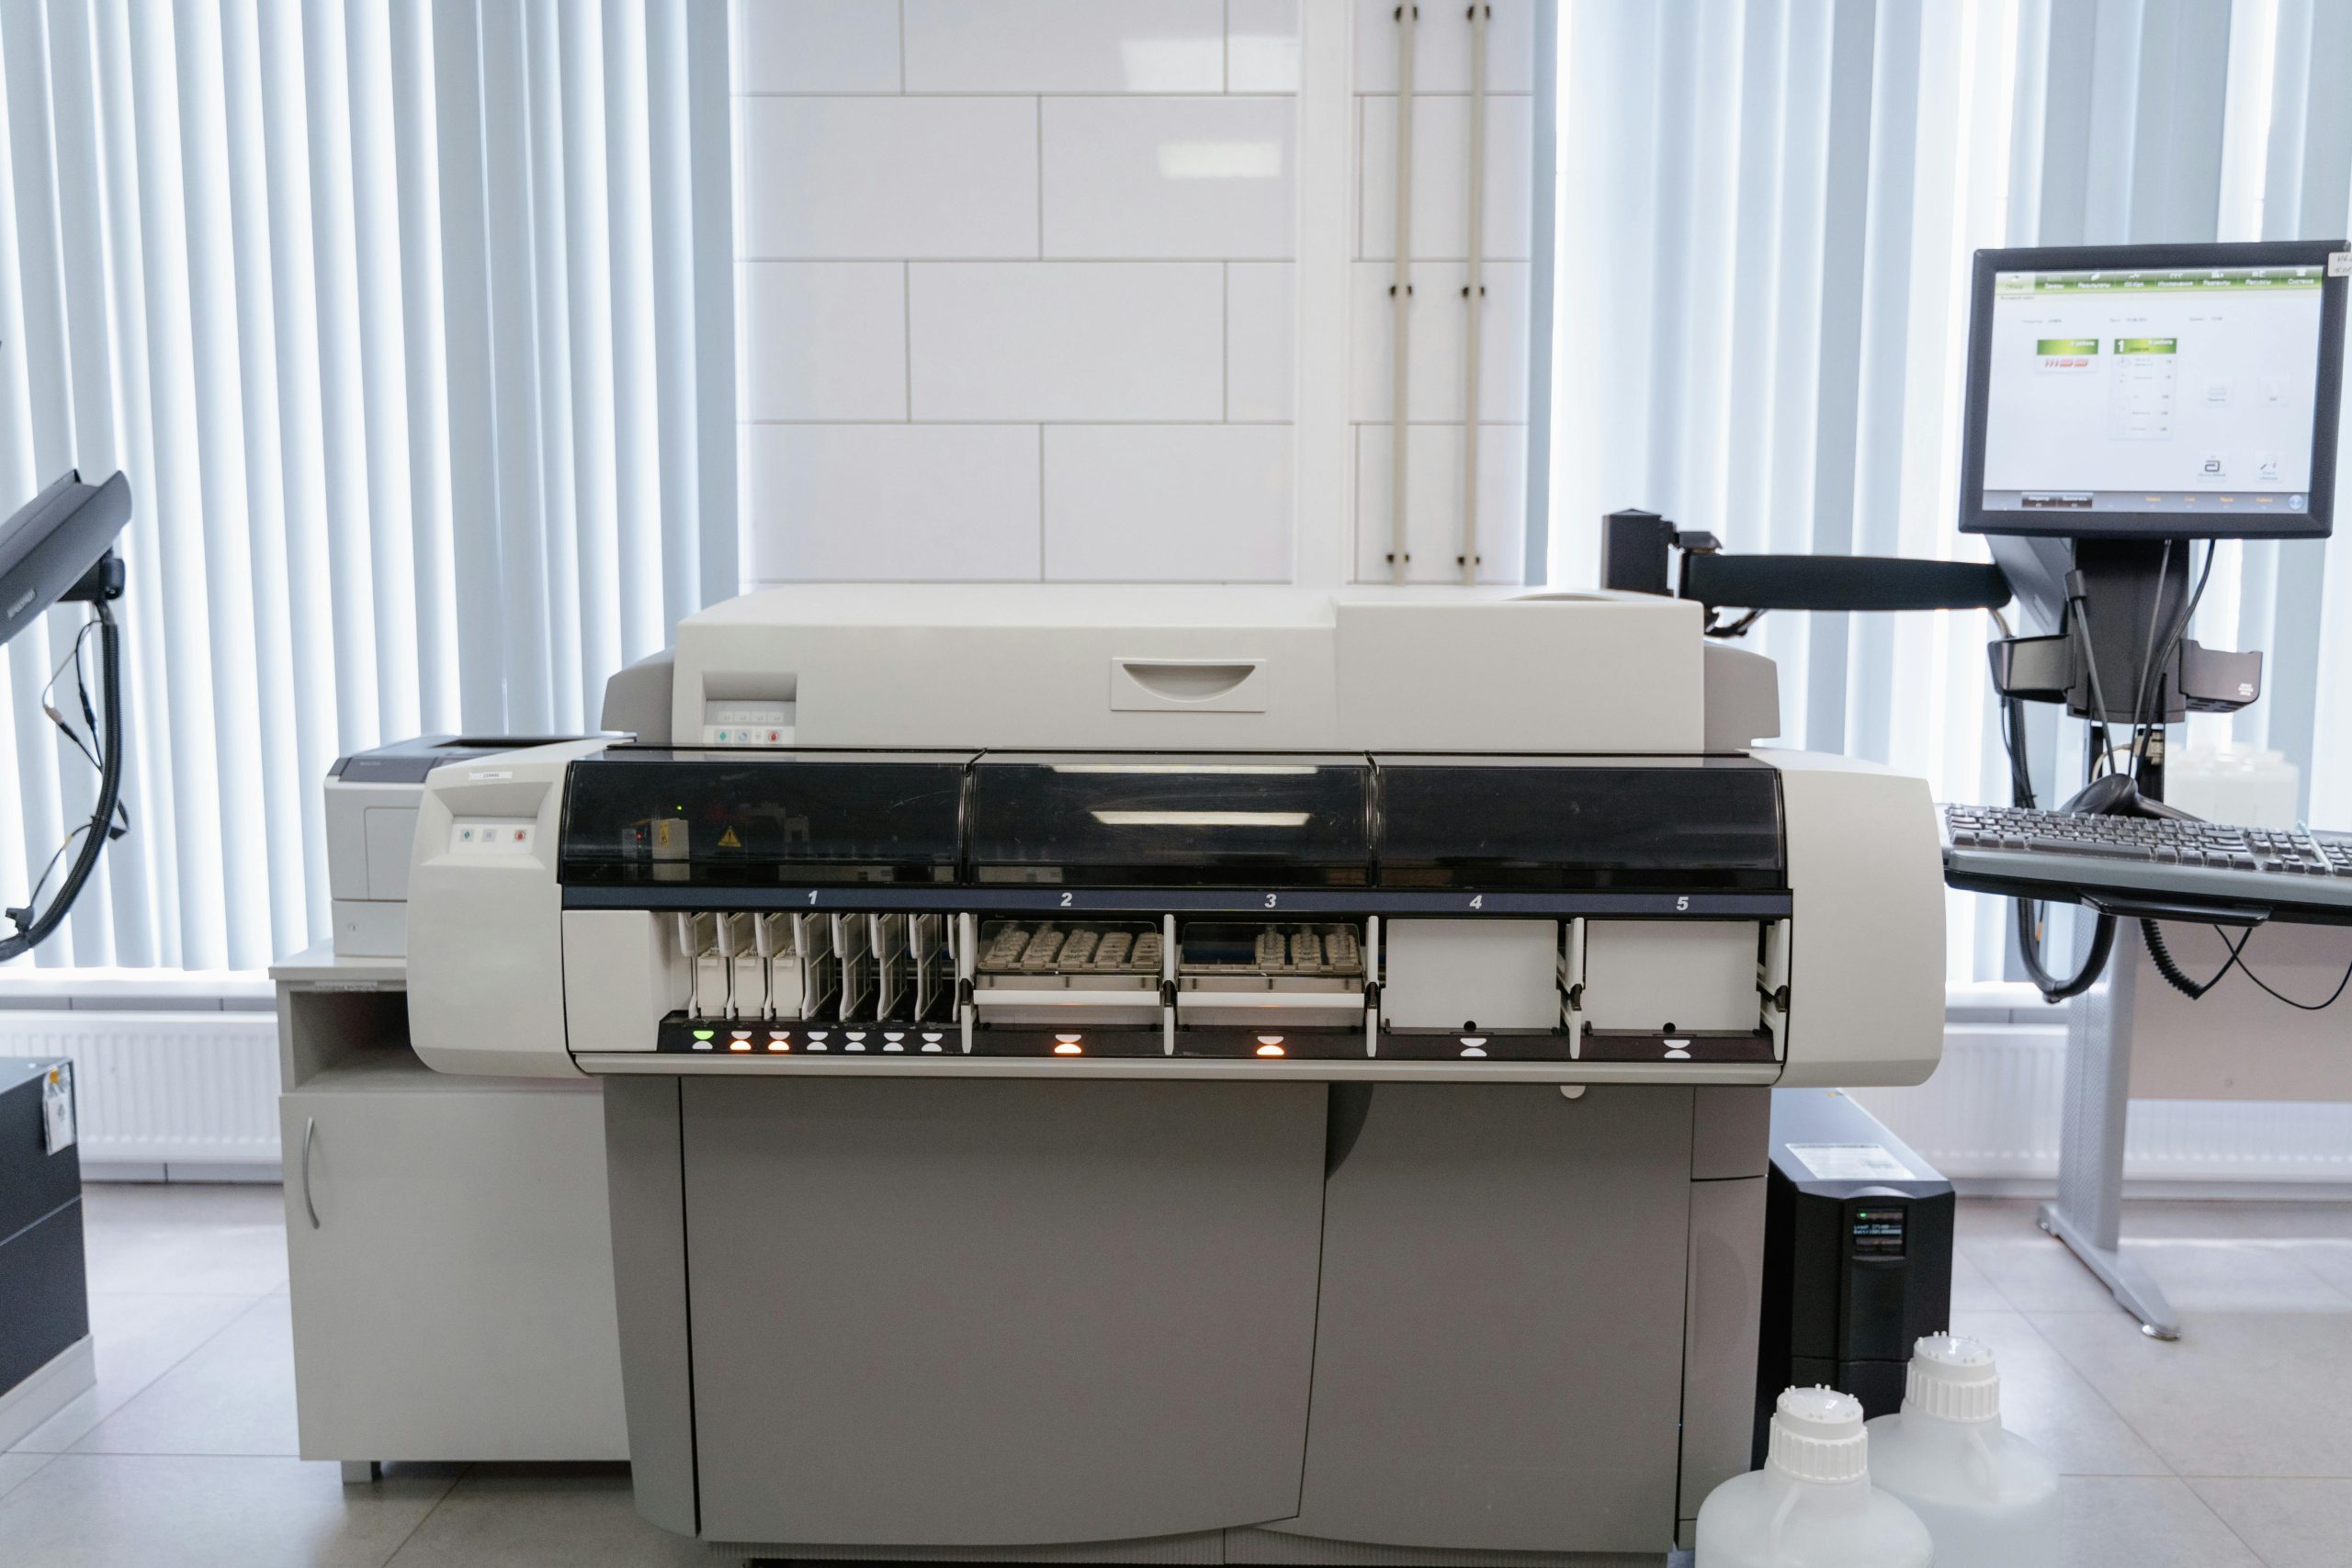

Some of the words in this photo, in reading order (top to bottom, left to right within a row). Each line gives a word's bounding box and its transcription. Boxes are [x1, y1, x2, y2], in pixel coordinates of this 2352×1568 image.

[2117, 340, 2125, 353] 1
[808, 890, 818, 905] 1
[1060, 892, 1073, 907] 2
[1264, 893, 1277, 908] 3
[1469, 895, 1483, 909] 4
[1676, 897, 1690, 911] 5
